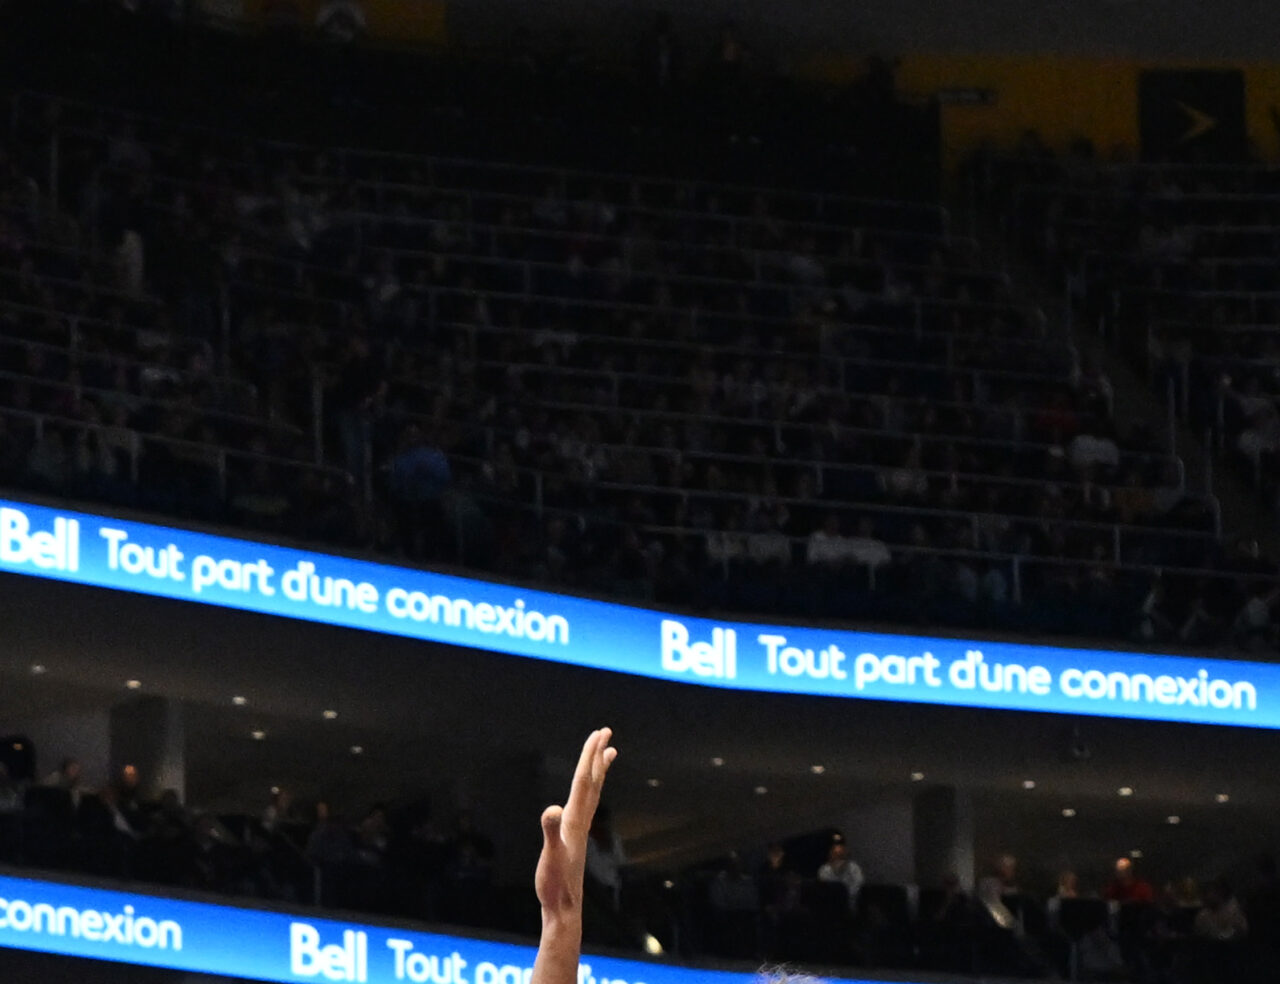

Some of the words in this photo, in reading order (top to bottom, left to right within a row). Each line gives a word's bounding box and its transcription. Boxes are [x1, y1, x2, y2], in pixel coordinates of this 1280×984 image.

[99, 526, 186, 581] Tout
[191, 554, 276, 596] part
[280, 560, 380, 614] d'une
[385, 587, 570, 645] connexion
[660, 618, 738, 681] Bell
[758, 633, 848, 681] Tout
[854, 650, 942, 691] part
[948, 648, 1053, 696] d'une
[1059, 667, 1258, 711] connexion
[290, 922, 368, 984] Bell
